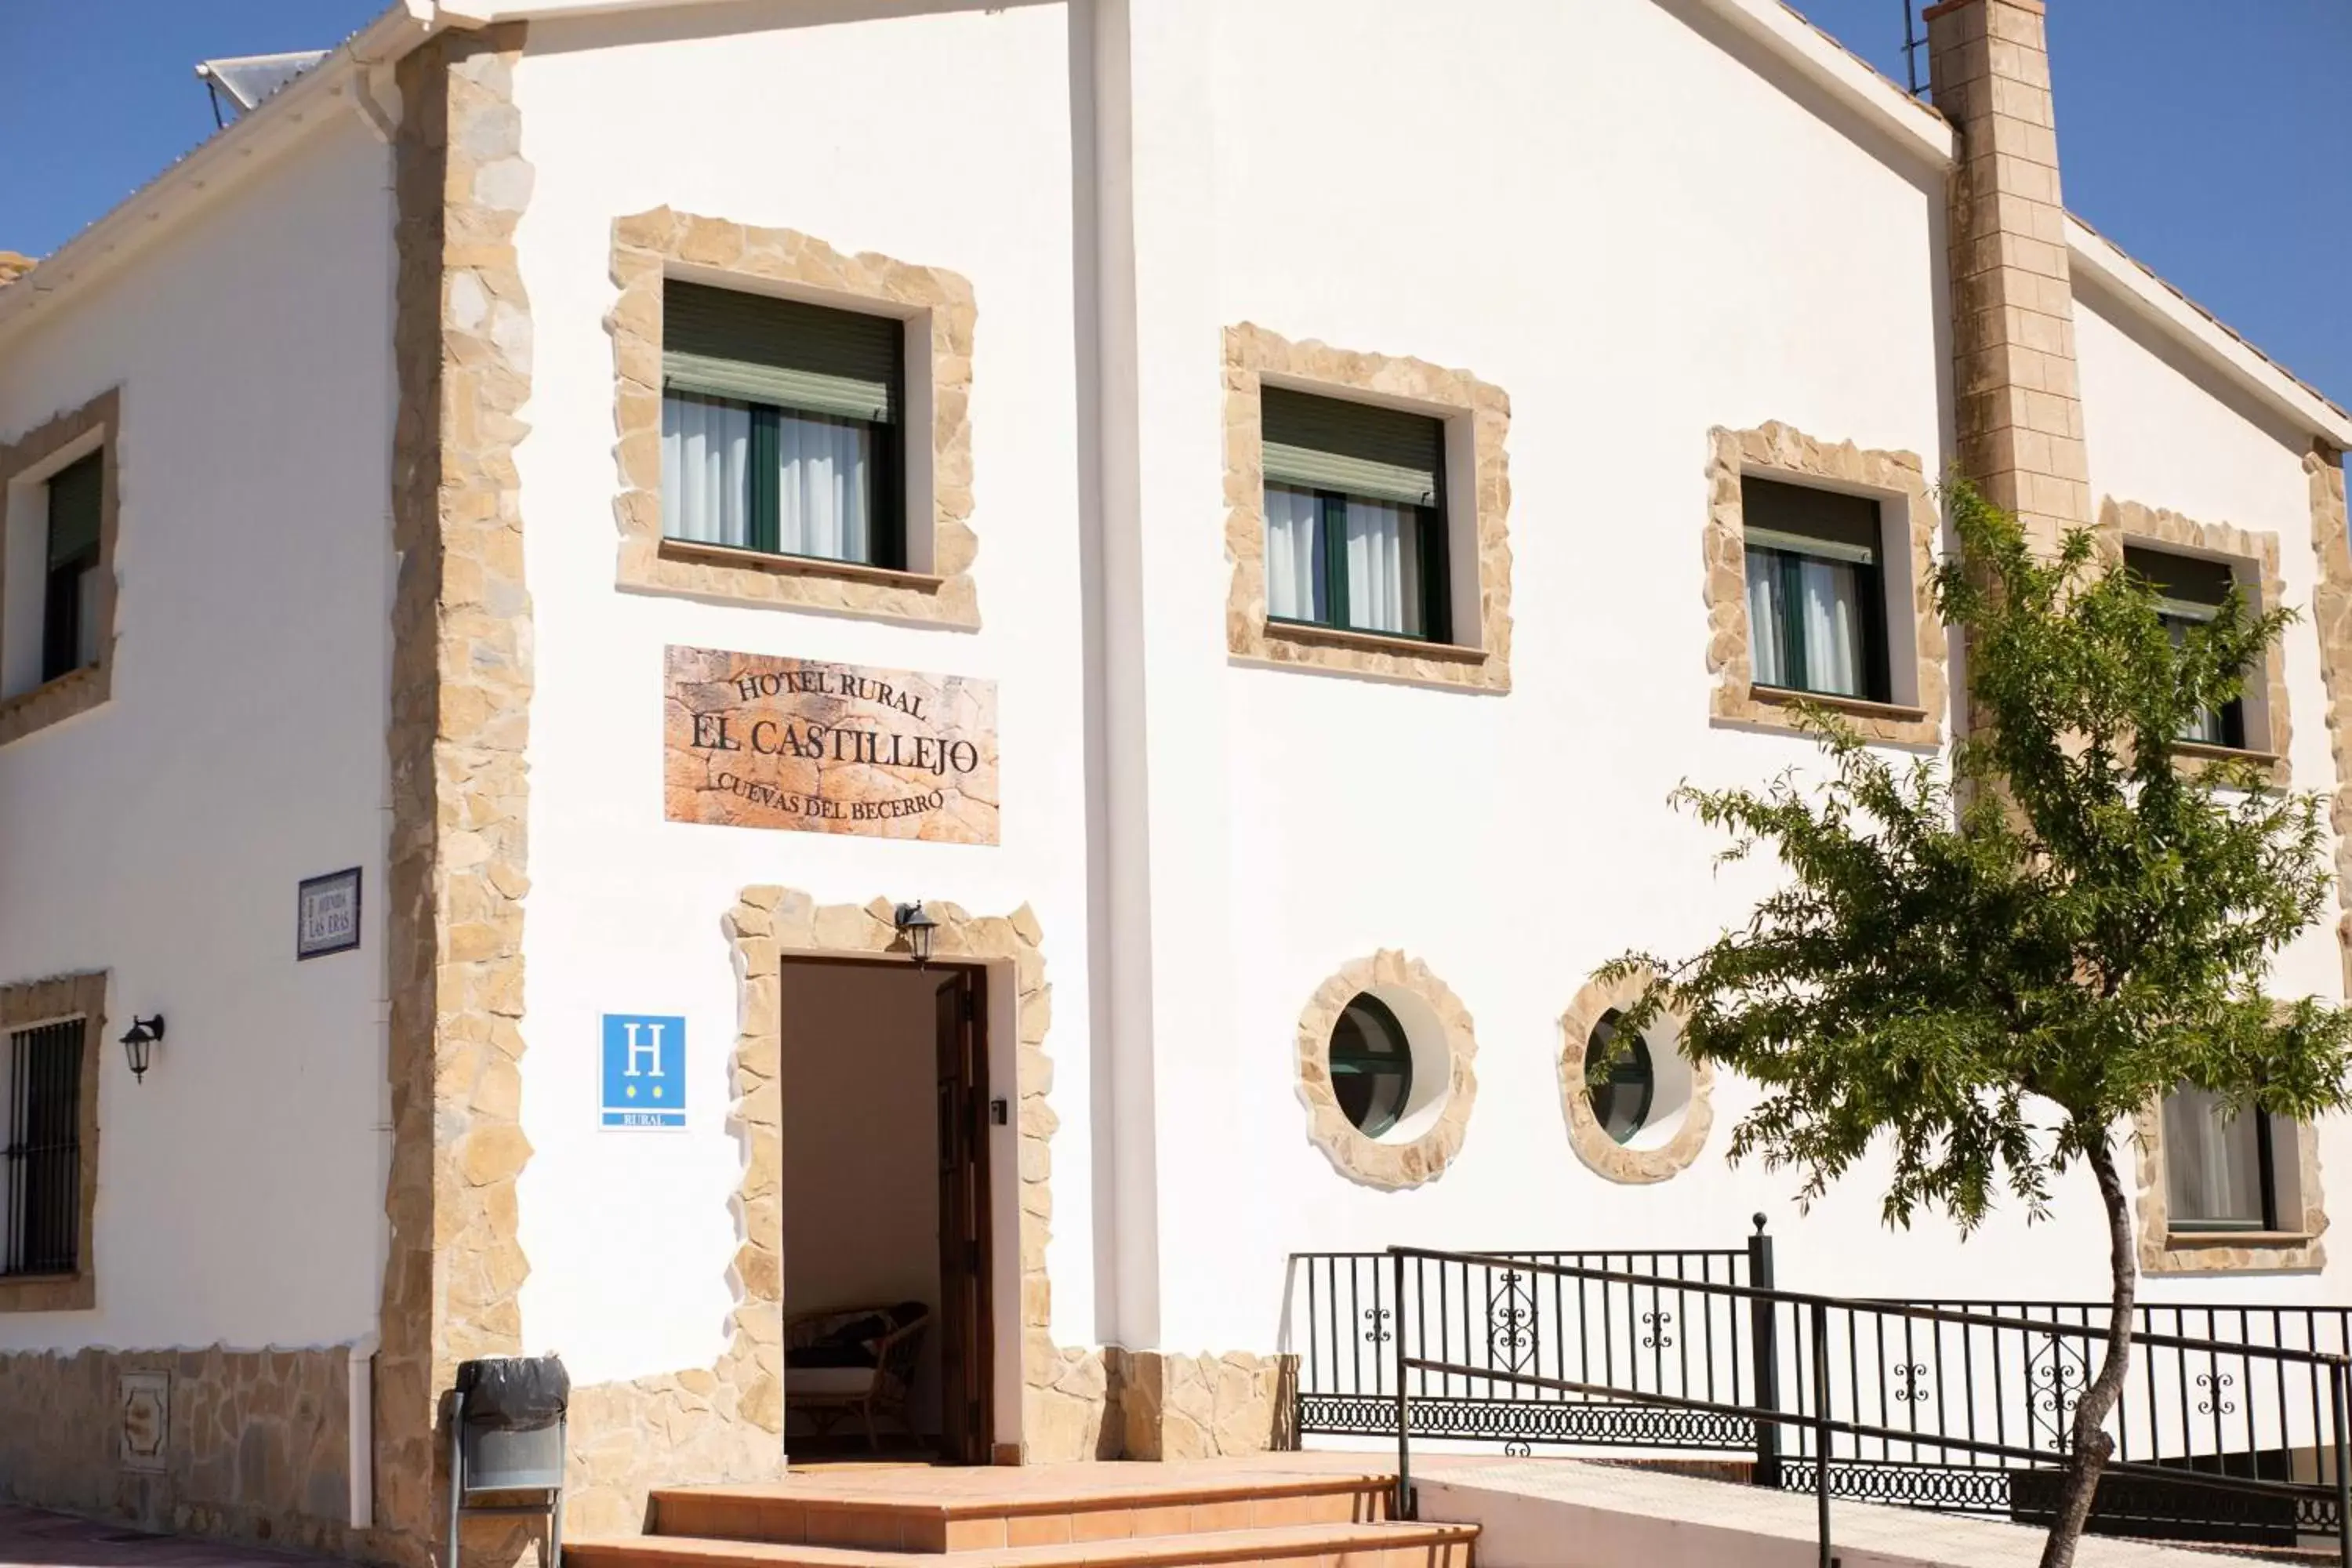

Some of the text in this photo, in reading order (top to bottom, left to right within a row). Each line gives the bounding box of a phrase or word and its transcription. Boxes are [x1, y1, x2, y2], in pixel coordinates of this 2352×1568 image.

[736, 670, 927, 722] HOTEL RURAL
[690, 713, 978, 776] EL CASTILLEJO
[717, 772, 944, 821] CUEVAS DEL BECERRO
[622, 1023, 666, 1076] H
[623, 1114, 665, 1126] RURAL
